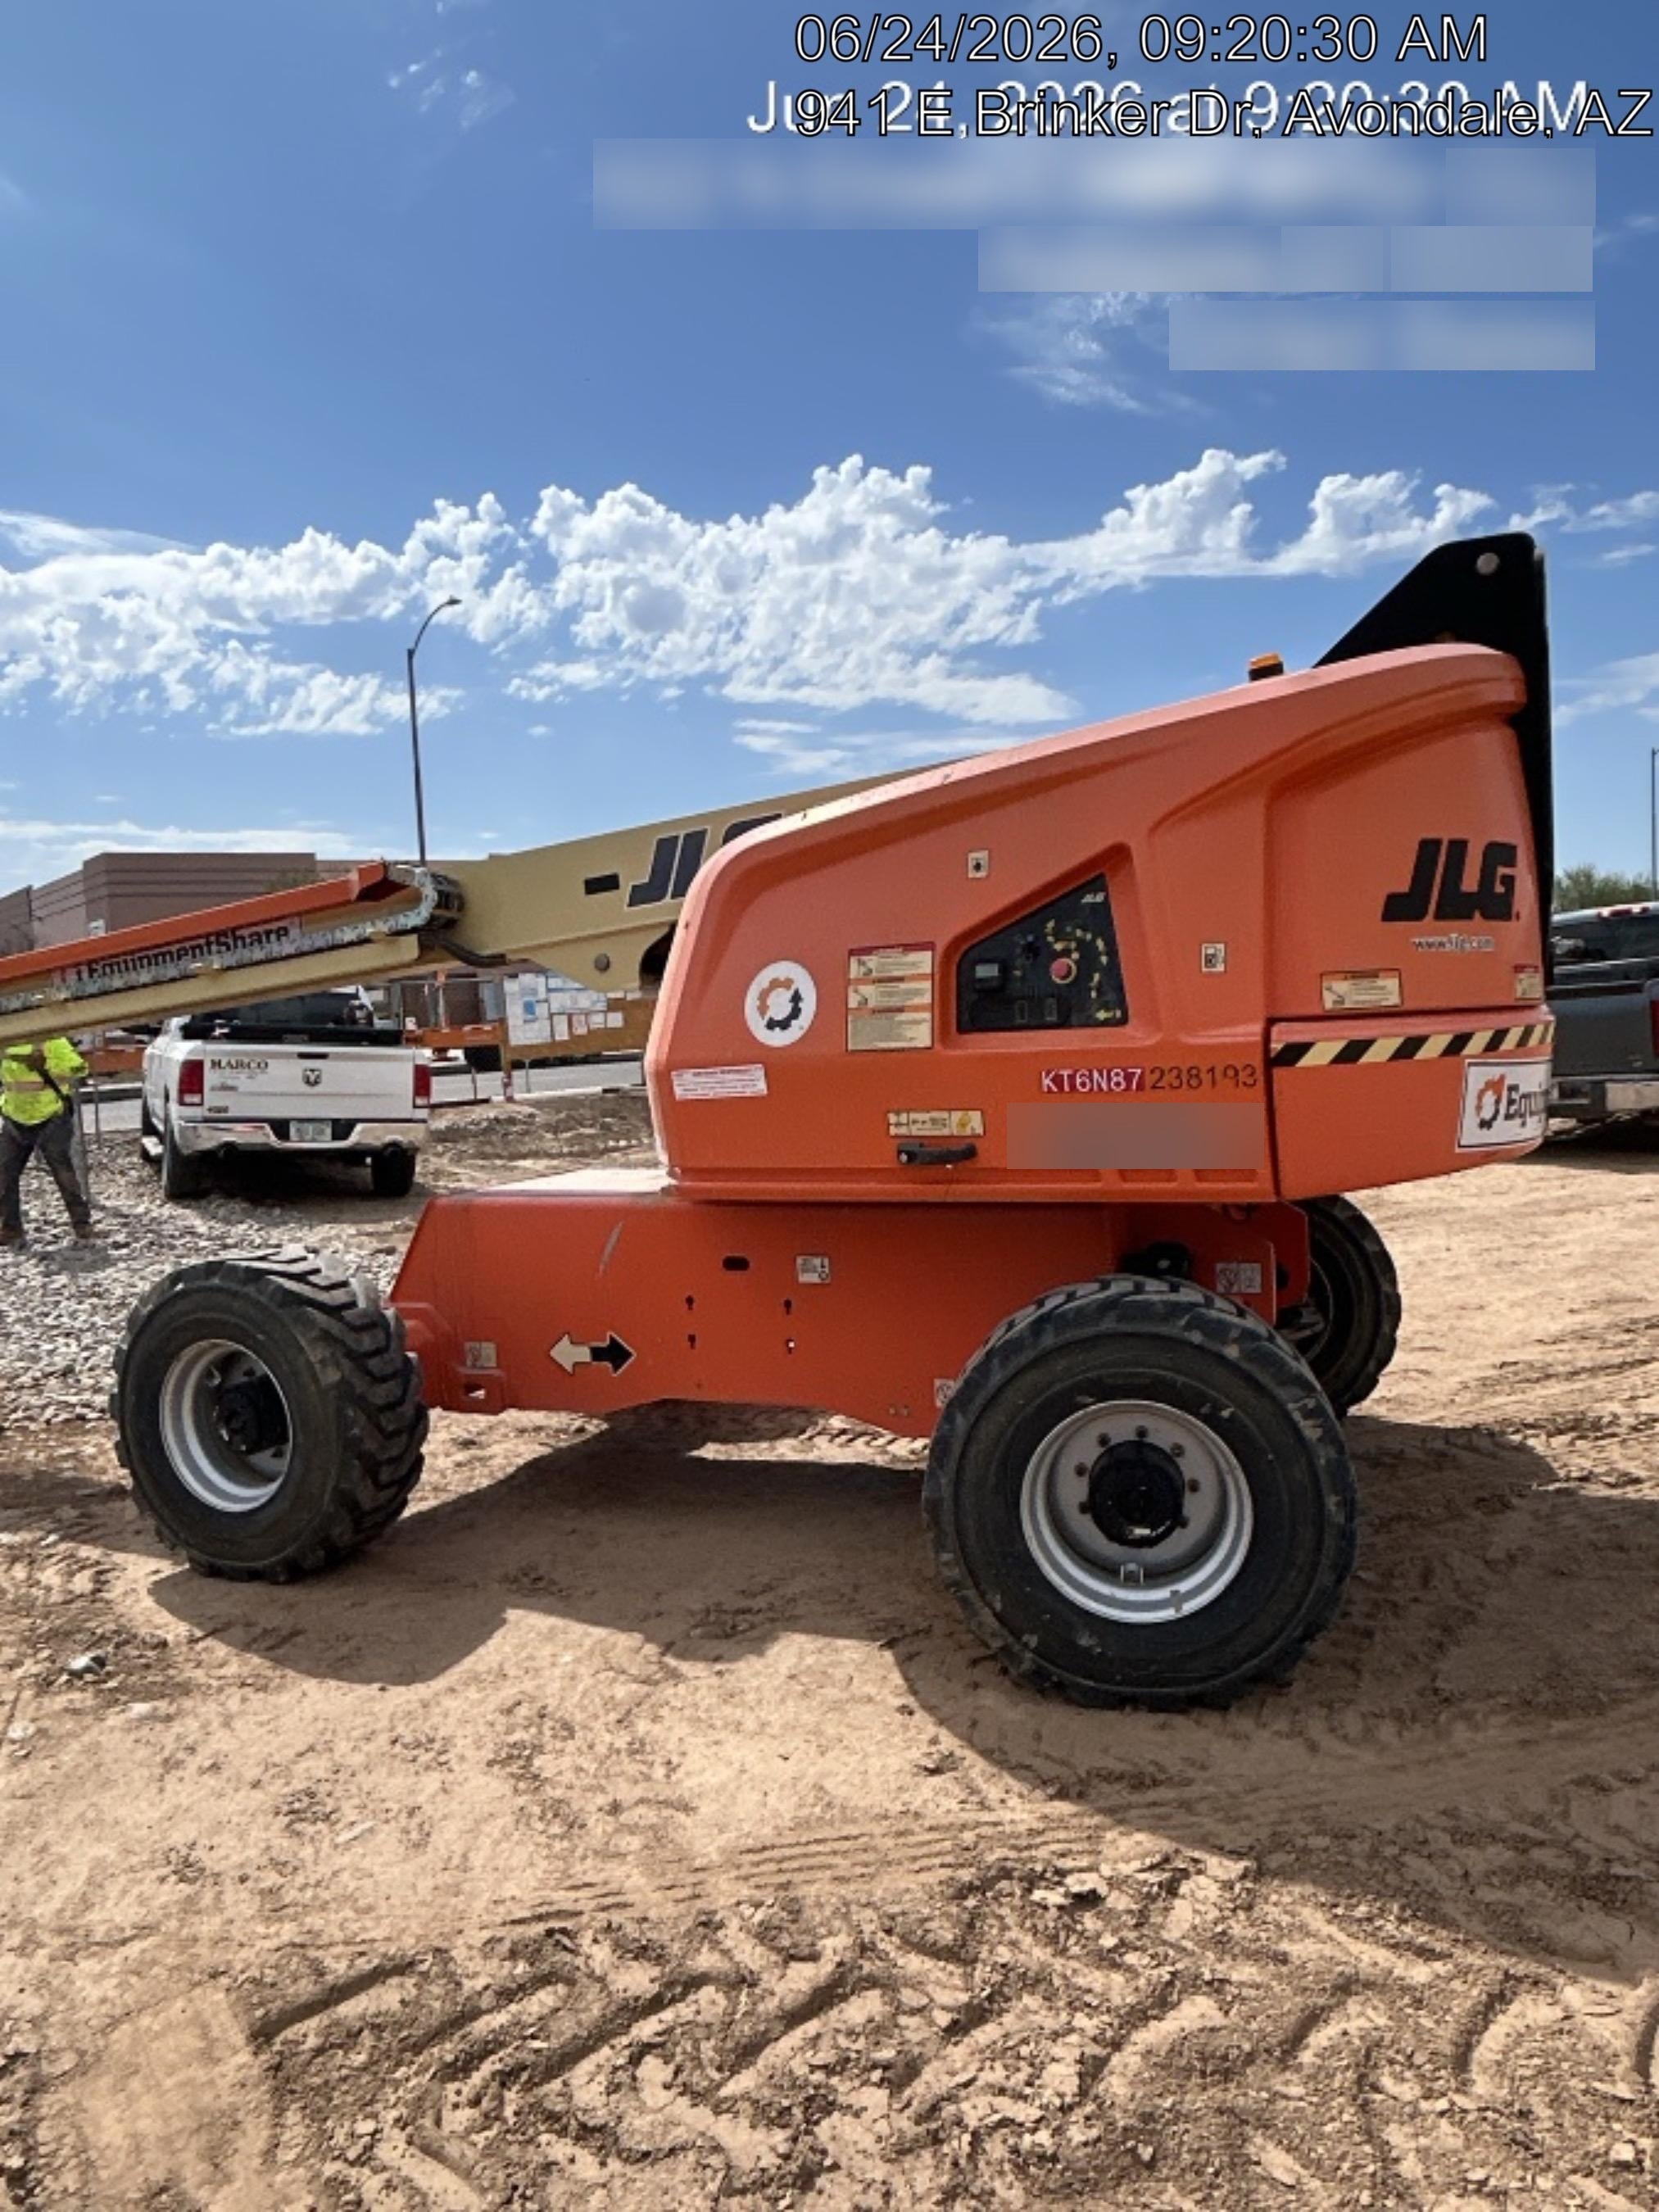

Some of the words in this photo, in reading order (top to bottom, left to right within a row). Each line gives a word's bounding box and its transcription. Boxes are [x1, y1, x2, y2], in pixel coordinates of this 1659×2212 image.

[1381, 837, 1517, 922] JLG
[1041, 1067, 1143, 1092] KT6N87
[1149, 1063, 1258, 1090] 238193
